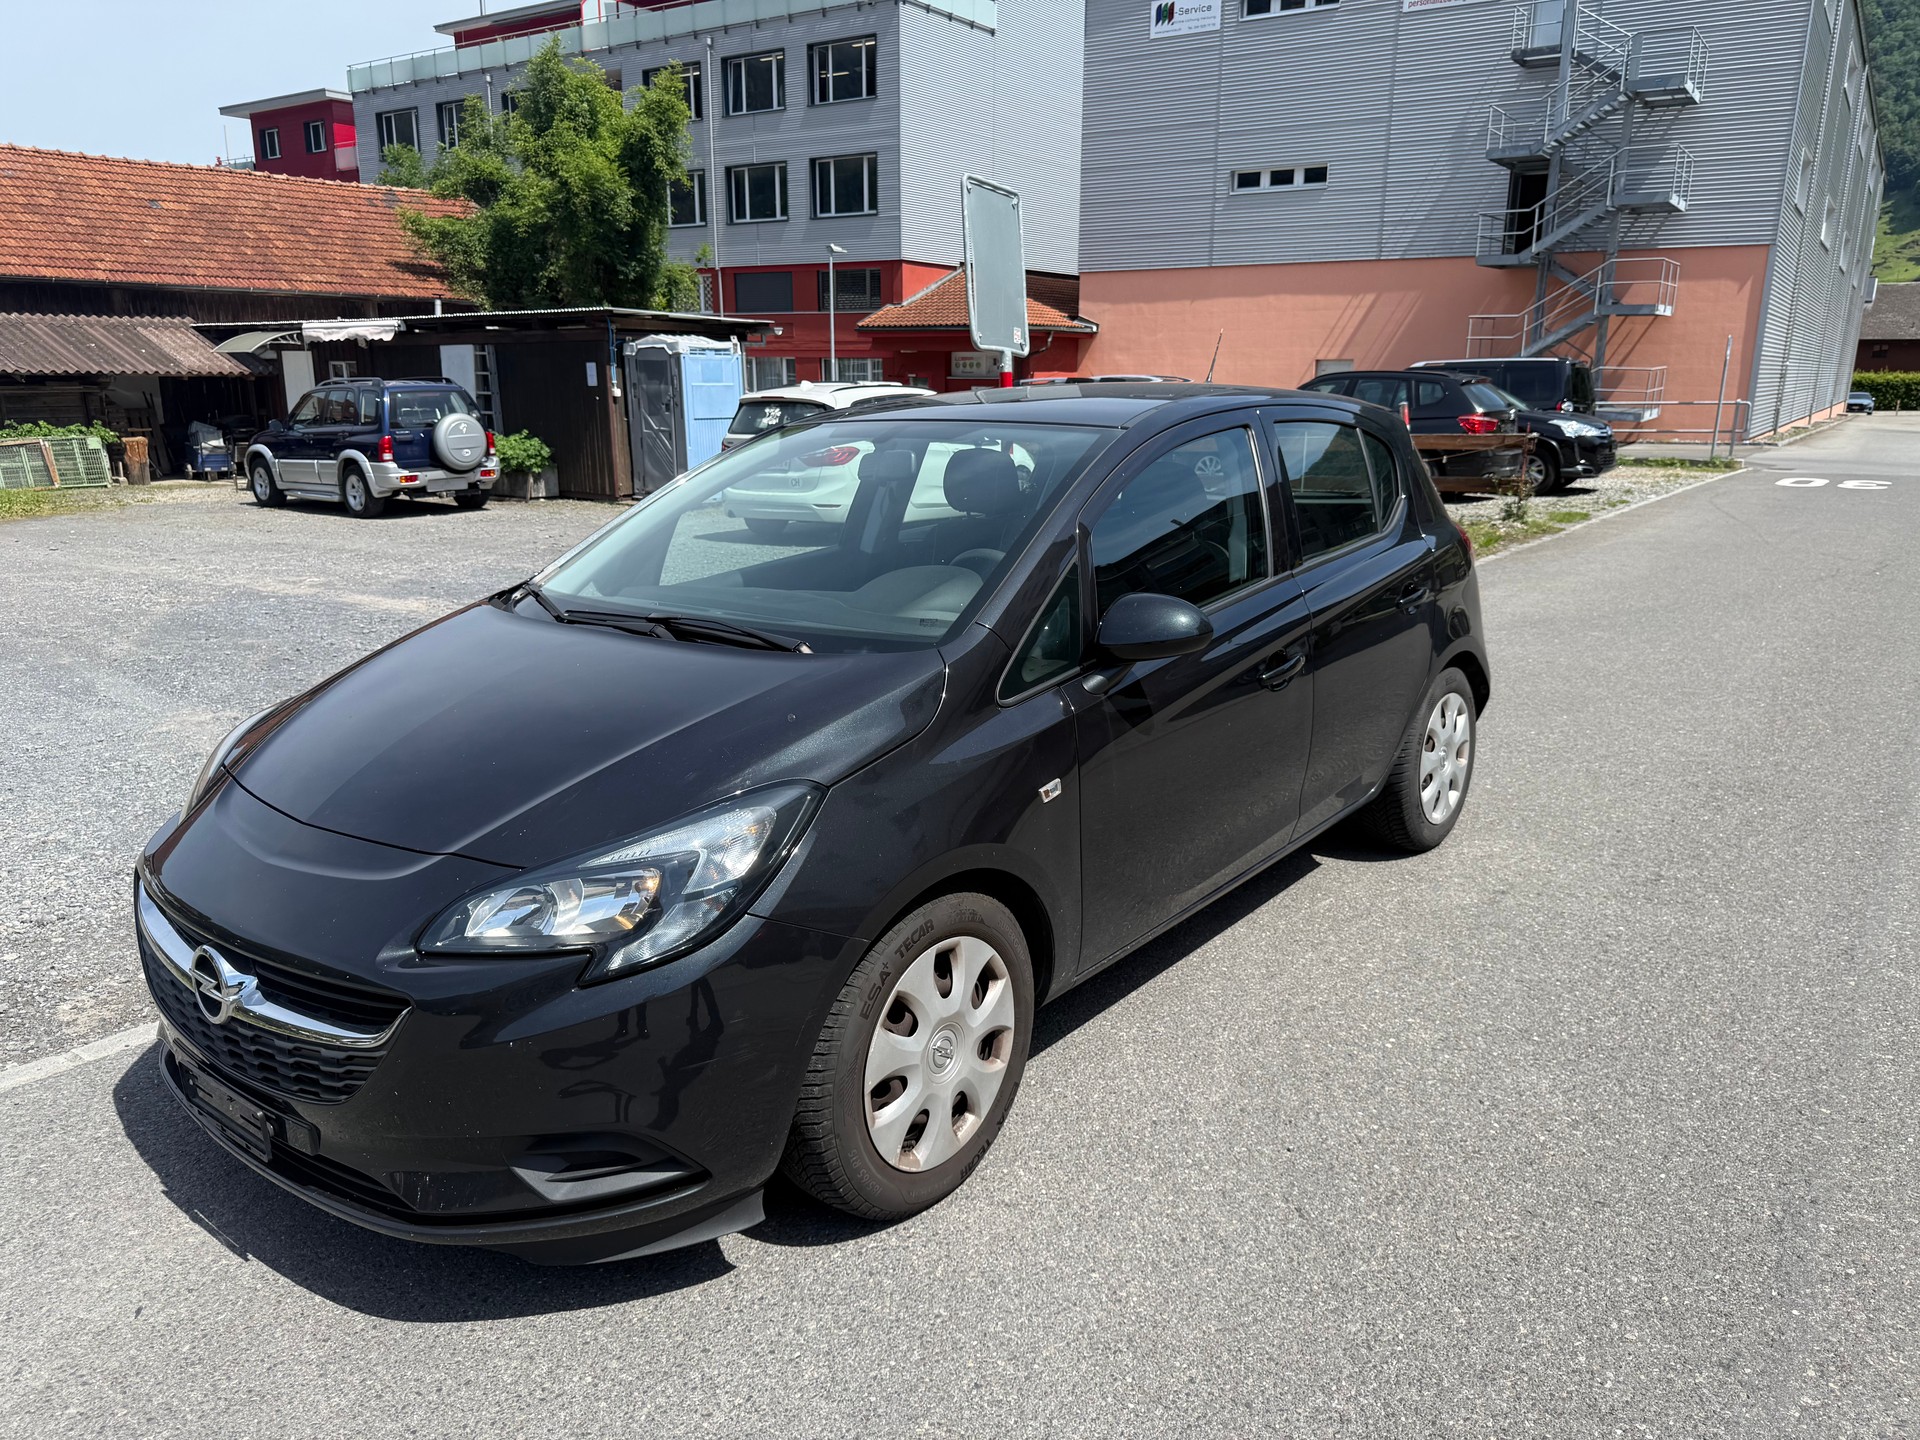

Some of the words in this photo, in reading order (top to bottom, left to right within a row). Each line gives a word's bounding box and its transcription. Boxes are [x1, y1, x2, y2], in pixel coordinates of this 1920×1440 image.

[790, 477, 800, 487] CH
[1773, 477, 1893, 490] 30
[894, 918, 935, 959] TECAR
